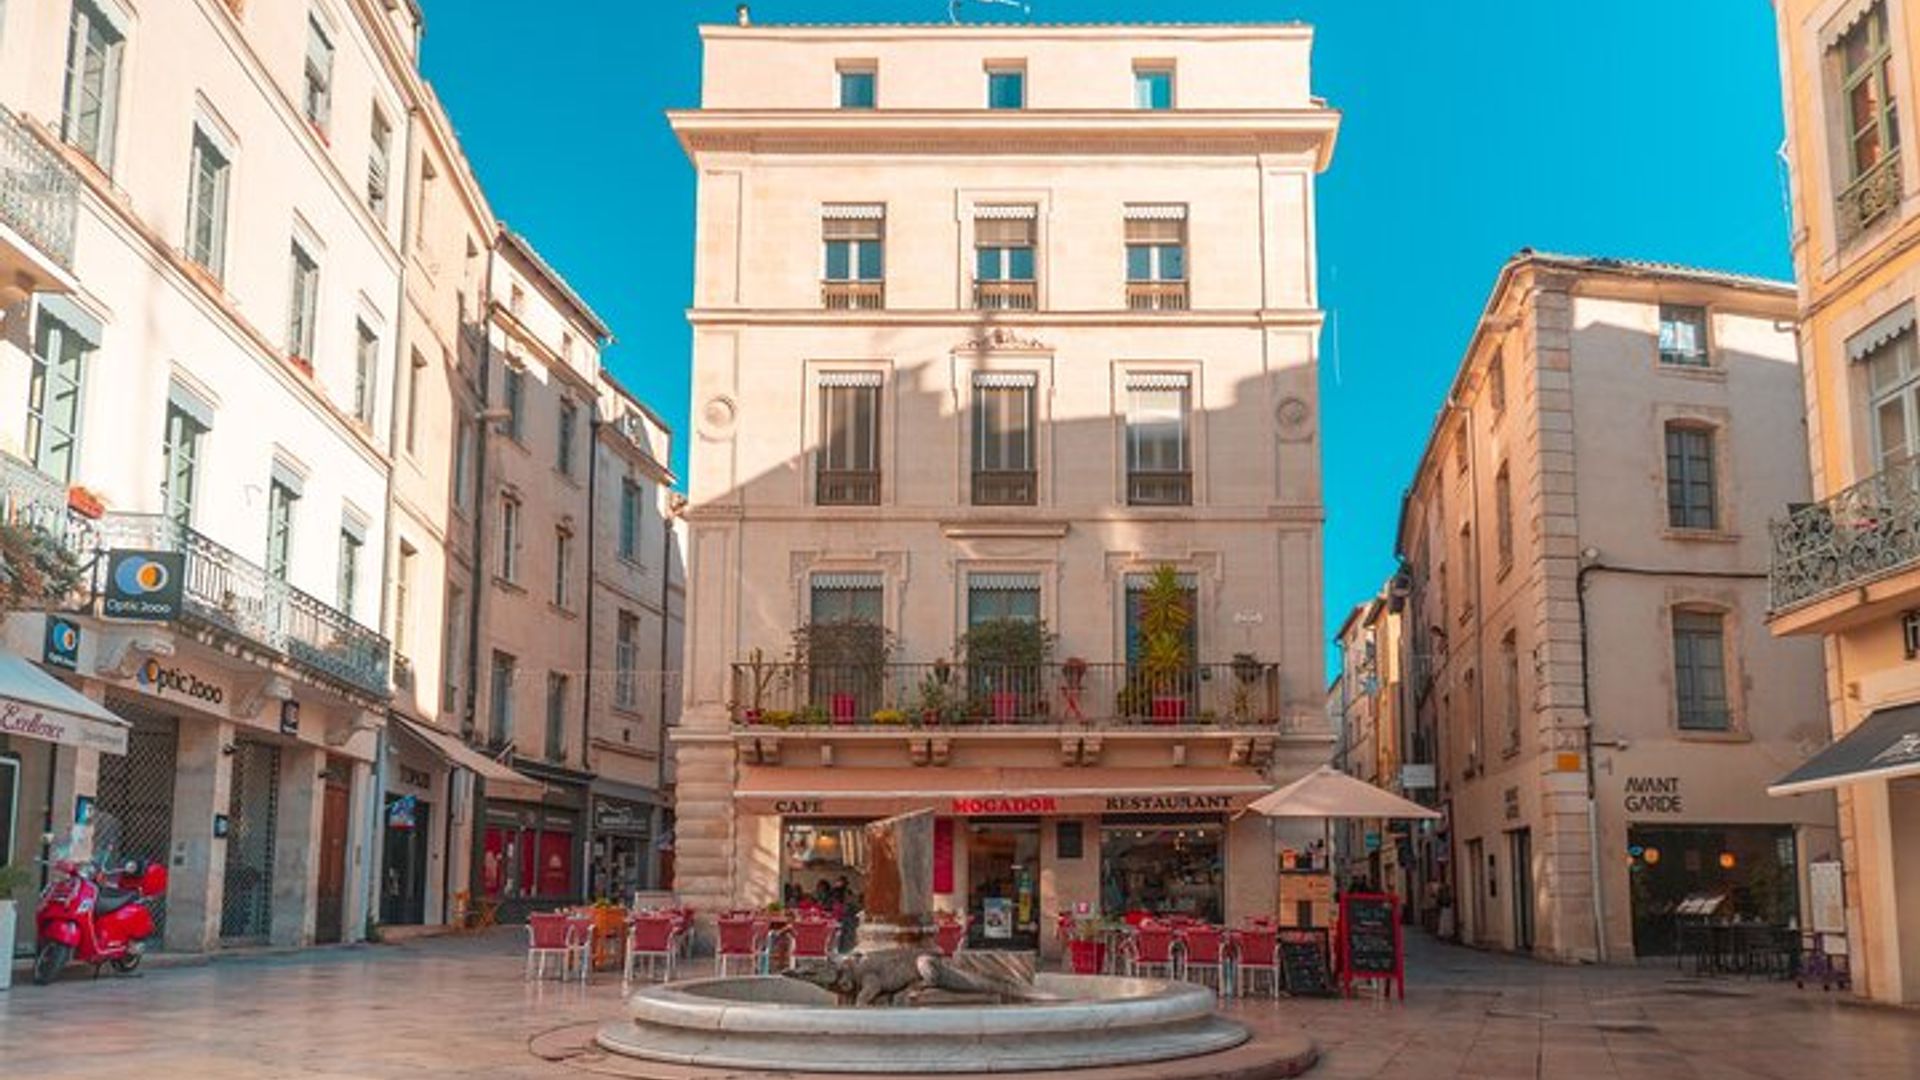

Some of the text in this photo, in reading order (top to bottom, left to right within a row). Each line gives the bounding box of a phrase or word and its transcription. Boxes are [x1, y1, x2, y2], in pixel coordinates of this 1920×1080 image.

[1624, 777, 1679, 793] AVANT
[775, 796, 1233, 814] CAFE MOGADOR RESTAURANT
[1624, 795, 1683, 813] GARDE
